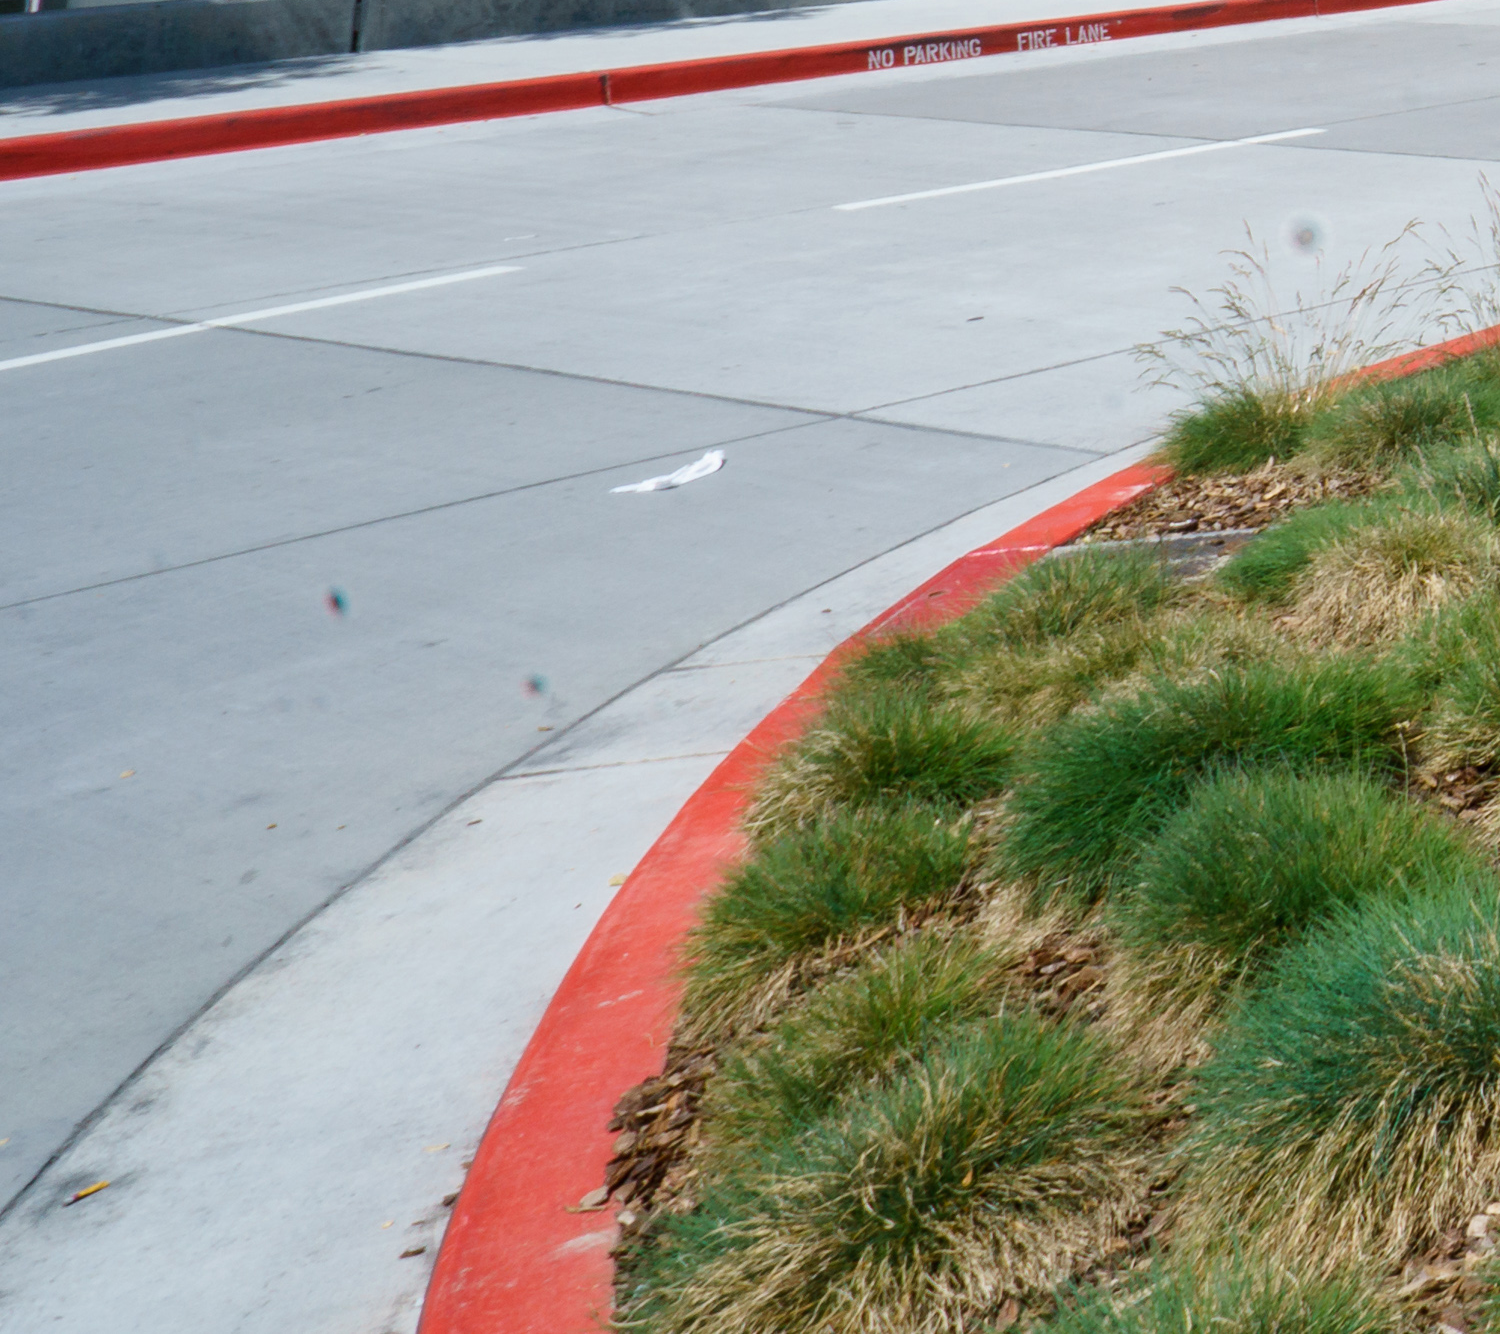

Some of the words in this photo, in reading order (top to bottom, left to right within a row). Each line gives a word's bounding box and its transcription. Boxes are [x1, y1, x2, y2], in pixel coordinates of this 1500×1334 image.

[1017, 28, 1058, 52] FIRE
[1065, 22, 1112, 46] LANE
[867, 49, 895, 70] NO
[903, 38, 982, 66] PARKING
